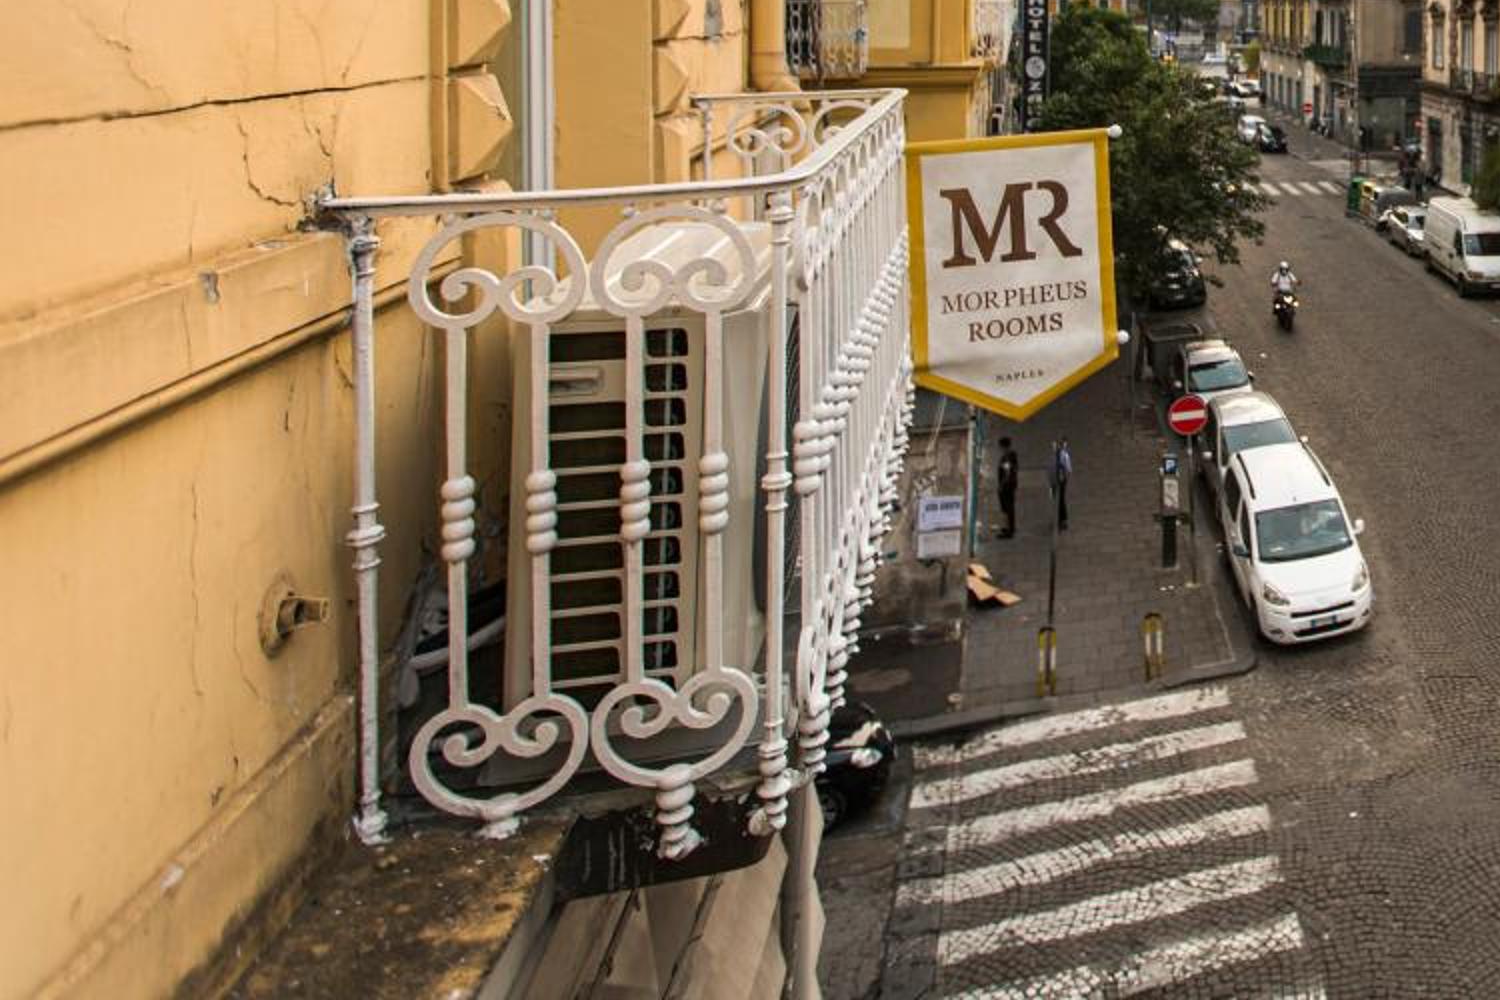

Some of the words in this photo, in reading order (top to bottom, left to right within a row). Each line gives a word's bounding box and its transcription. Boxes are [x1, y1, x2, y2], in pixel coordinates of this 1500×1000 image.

[940, 180, 1083, 268] MR
[942, 280, 1087, 315] MORPHEUS
[968, 312, 1063, 343] ROOMS
[995, 369, 1044, 384] NAPLES
